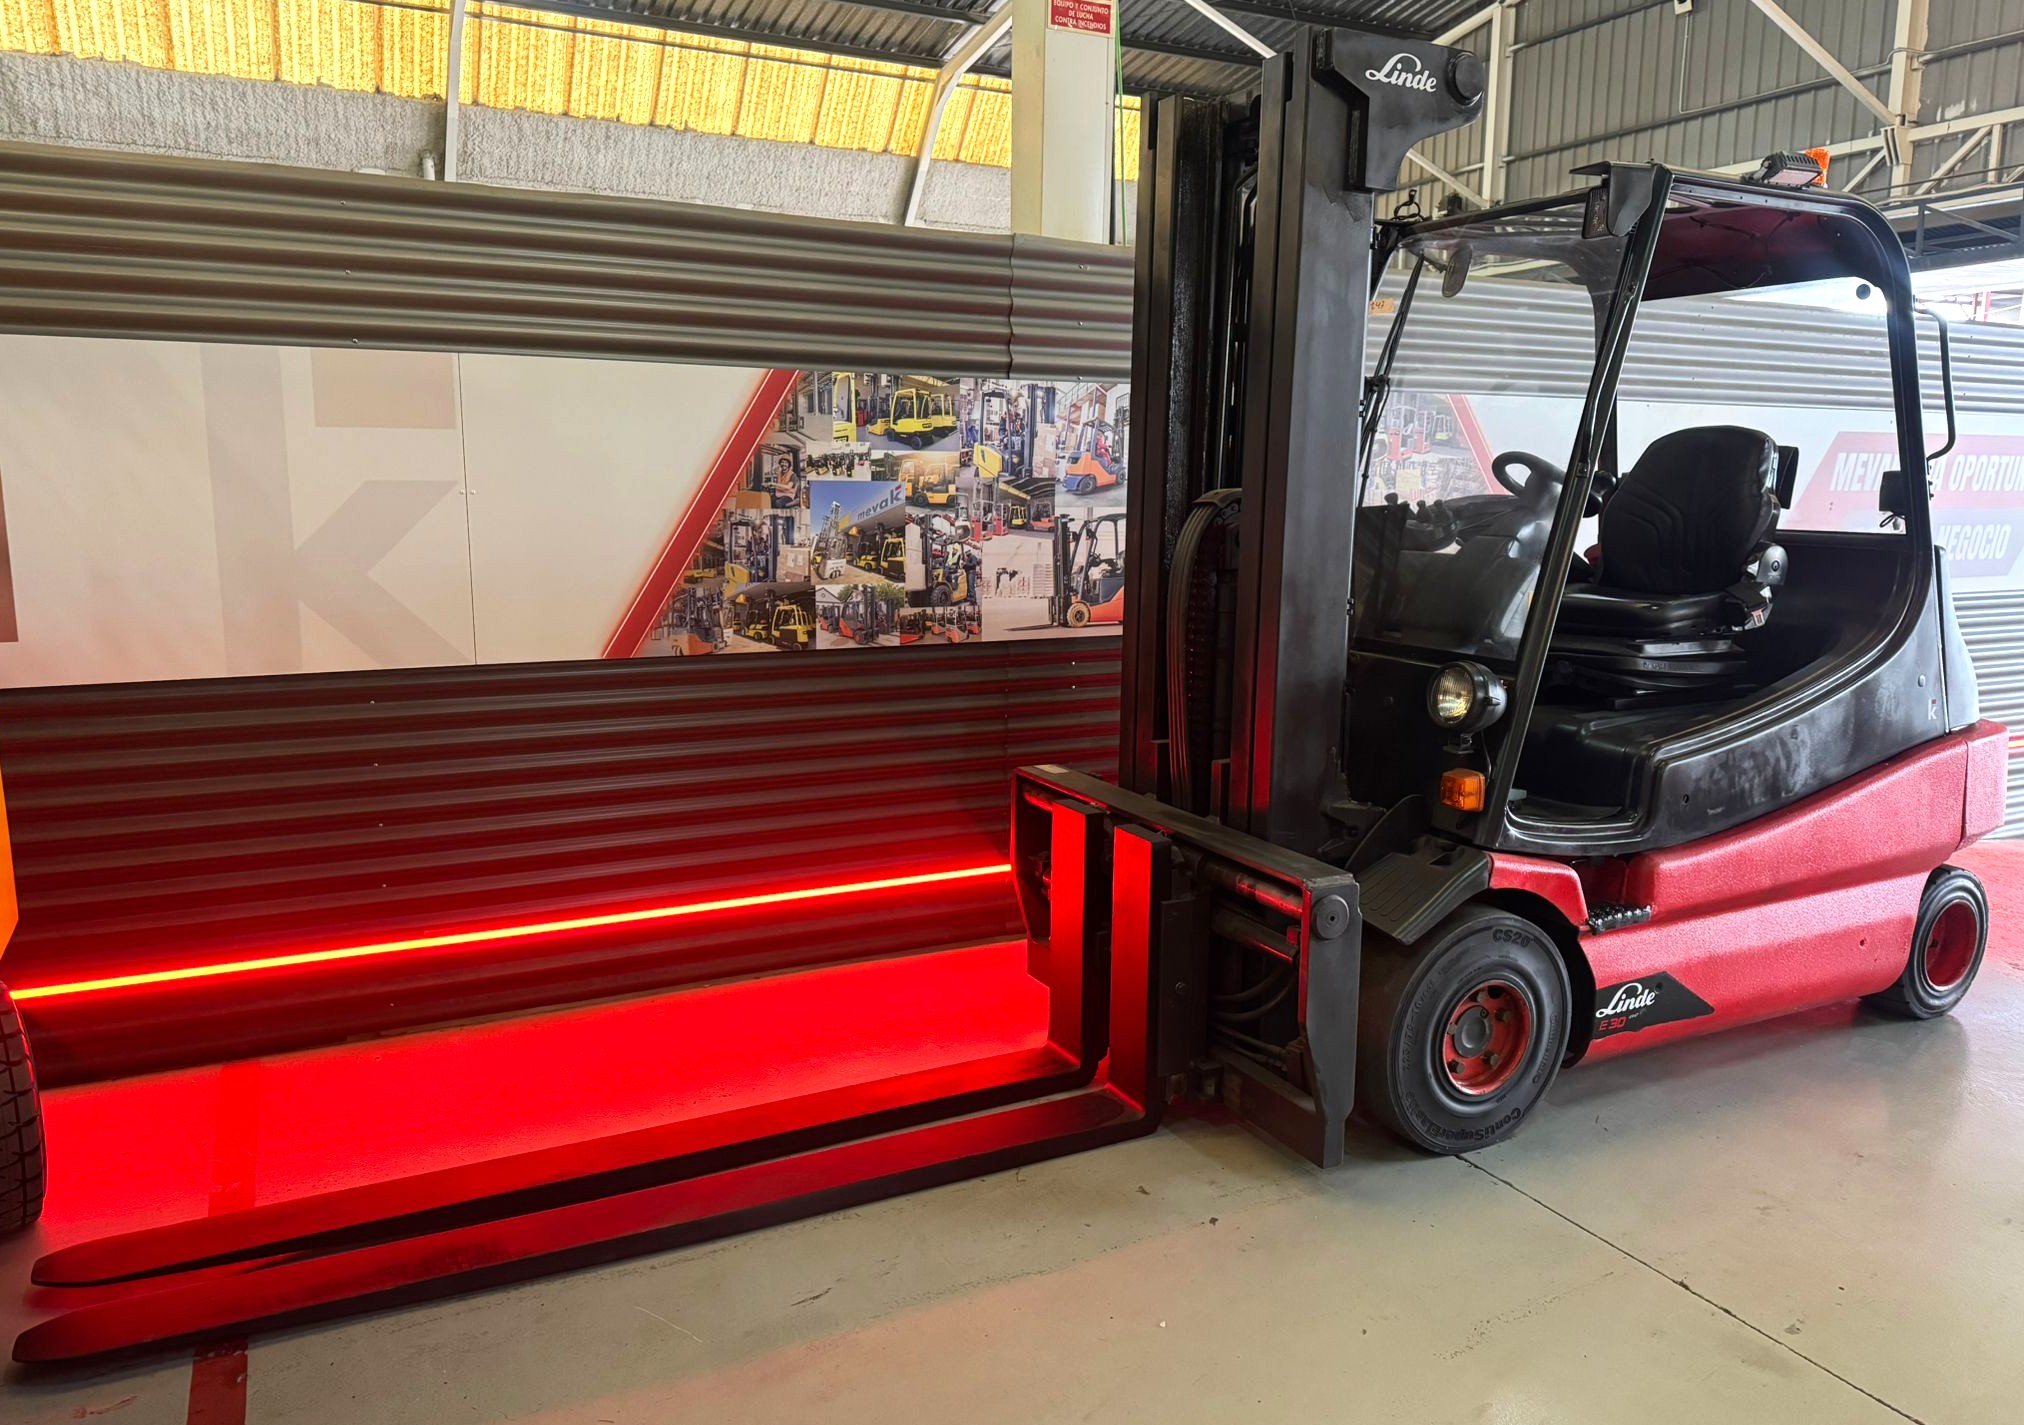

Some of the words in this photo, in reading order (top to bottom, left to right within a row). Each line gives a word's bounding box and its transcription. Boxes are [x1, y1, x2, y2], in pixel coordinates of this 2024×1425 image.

[1053, 0, 1074, 9] EQUIPO
[1080, 4, 1109, 15] CONJUNTO
[1077, 11, 1094, 20] LUCHA
[1054, 16, 1077, 25] CONTRA
[1077, 20, 1107, 30] INCENDIOS
[1365, 53, 1437, 93] Linde
[857, 484, 902, 520] mevak
[1492, 928, 1530, 948] CS20
[1596, 982, 1656, 1018] Linde
